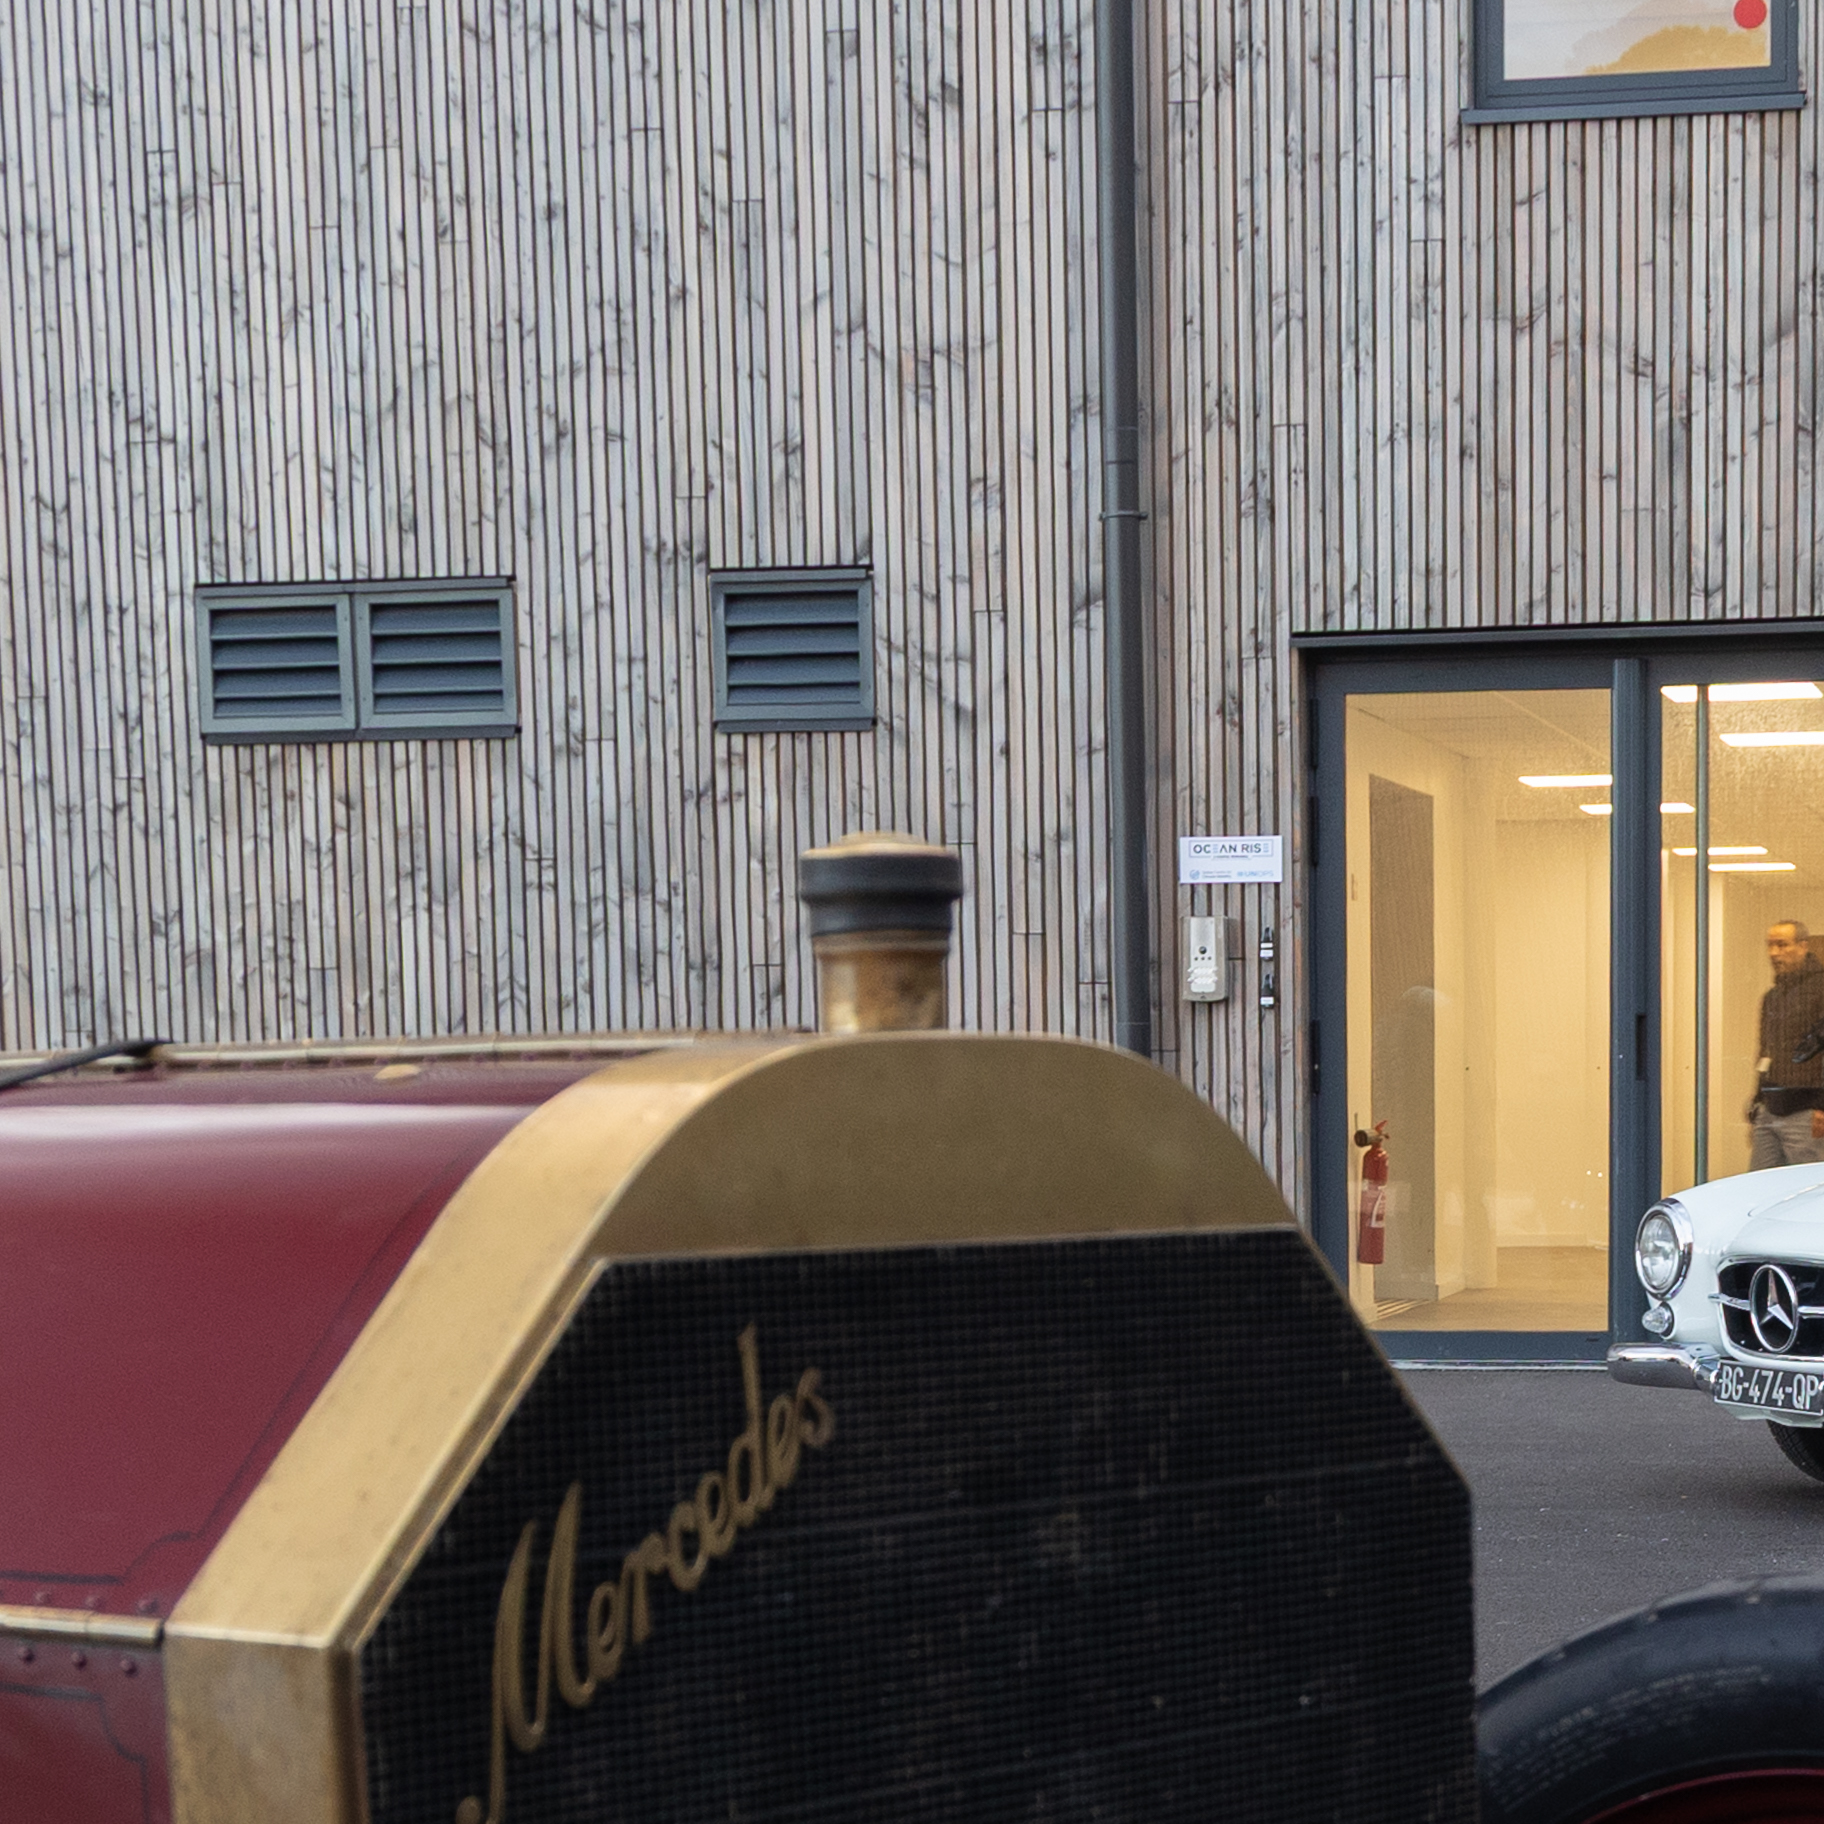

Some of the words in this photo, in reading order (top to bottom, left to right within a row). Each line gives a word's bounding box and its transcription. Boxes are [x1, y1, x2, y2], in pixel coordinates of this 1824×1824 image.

[1193, 843, 1237, 854] OCEAN
[1241, 843, 1269, 853] RISE
[1720, 1365, 1819, 1410] BG-474-QP
